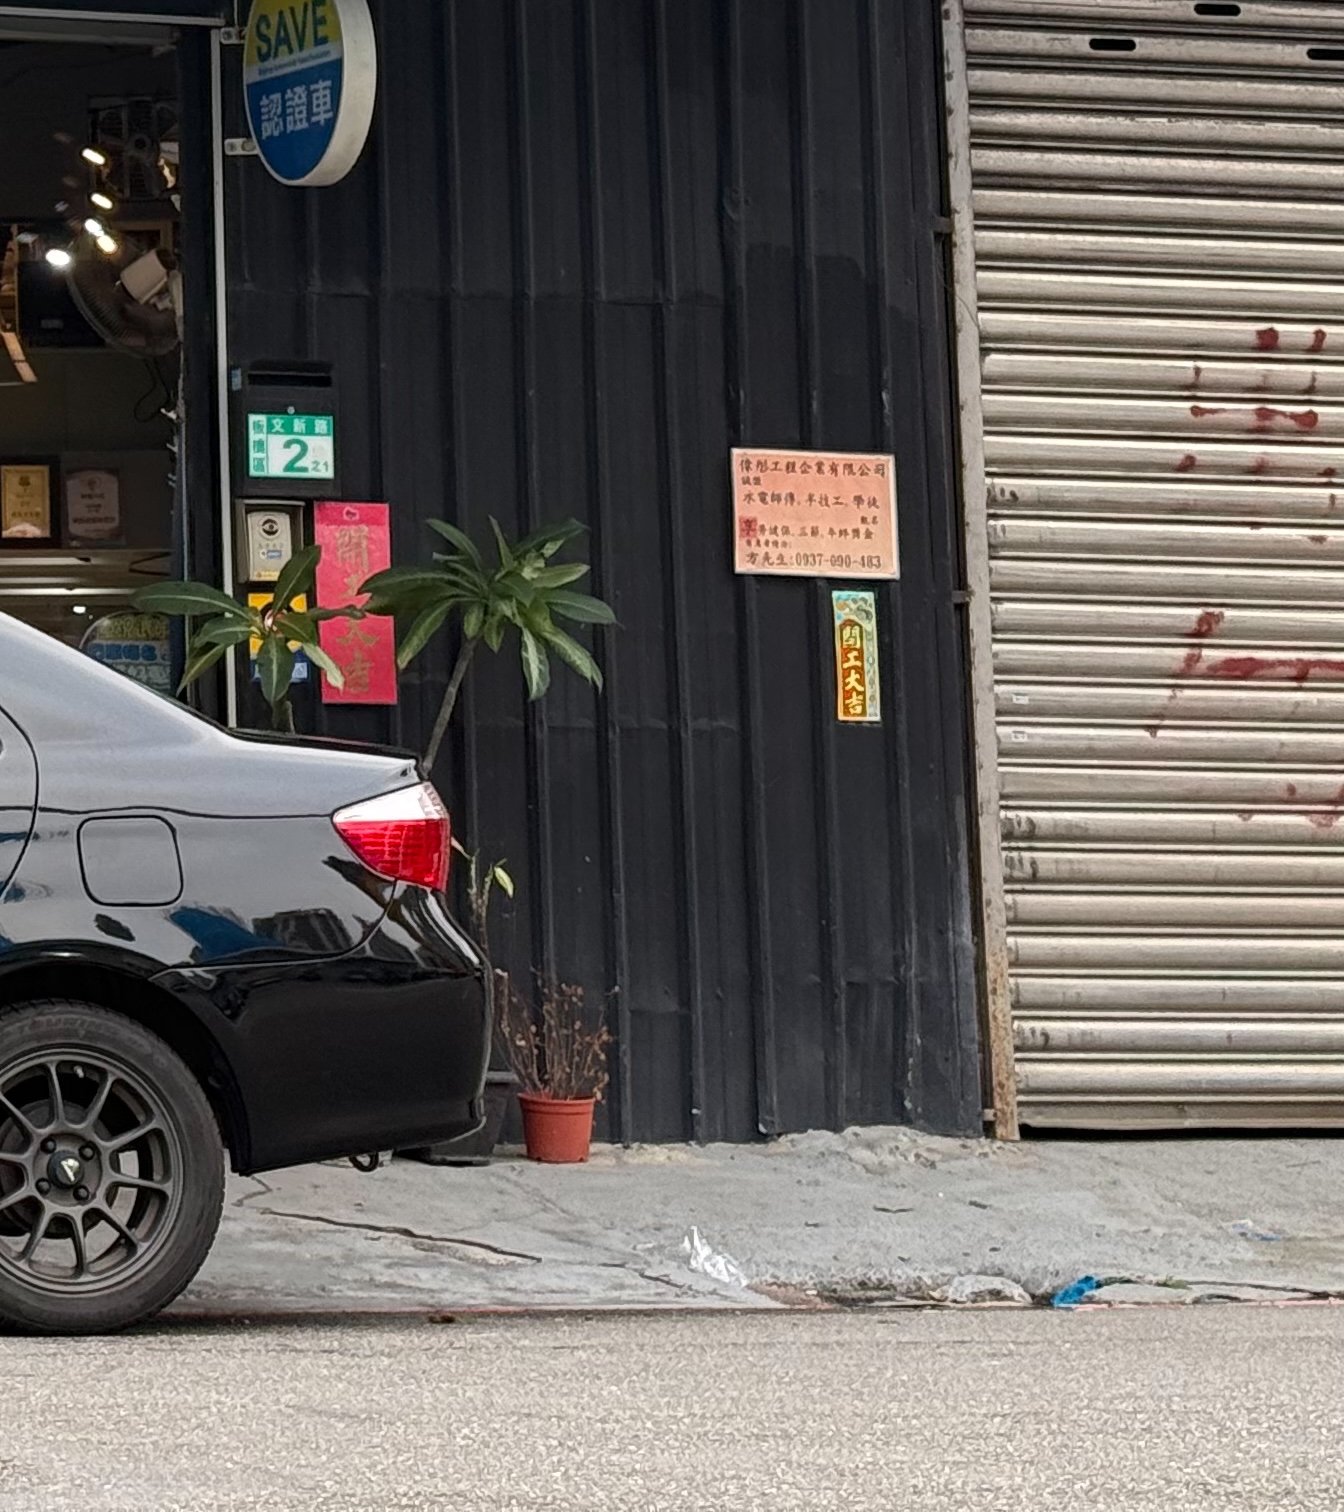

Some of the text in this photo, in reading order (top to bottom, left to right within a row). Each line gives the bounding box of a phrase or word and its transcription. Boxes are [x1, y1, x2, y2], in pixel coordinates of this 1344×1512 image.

[259, 79, 334, 140] 認證車
[282, 438, 310, 473] 2
[841, 625, 865, 715] 開工大吉
